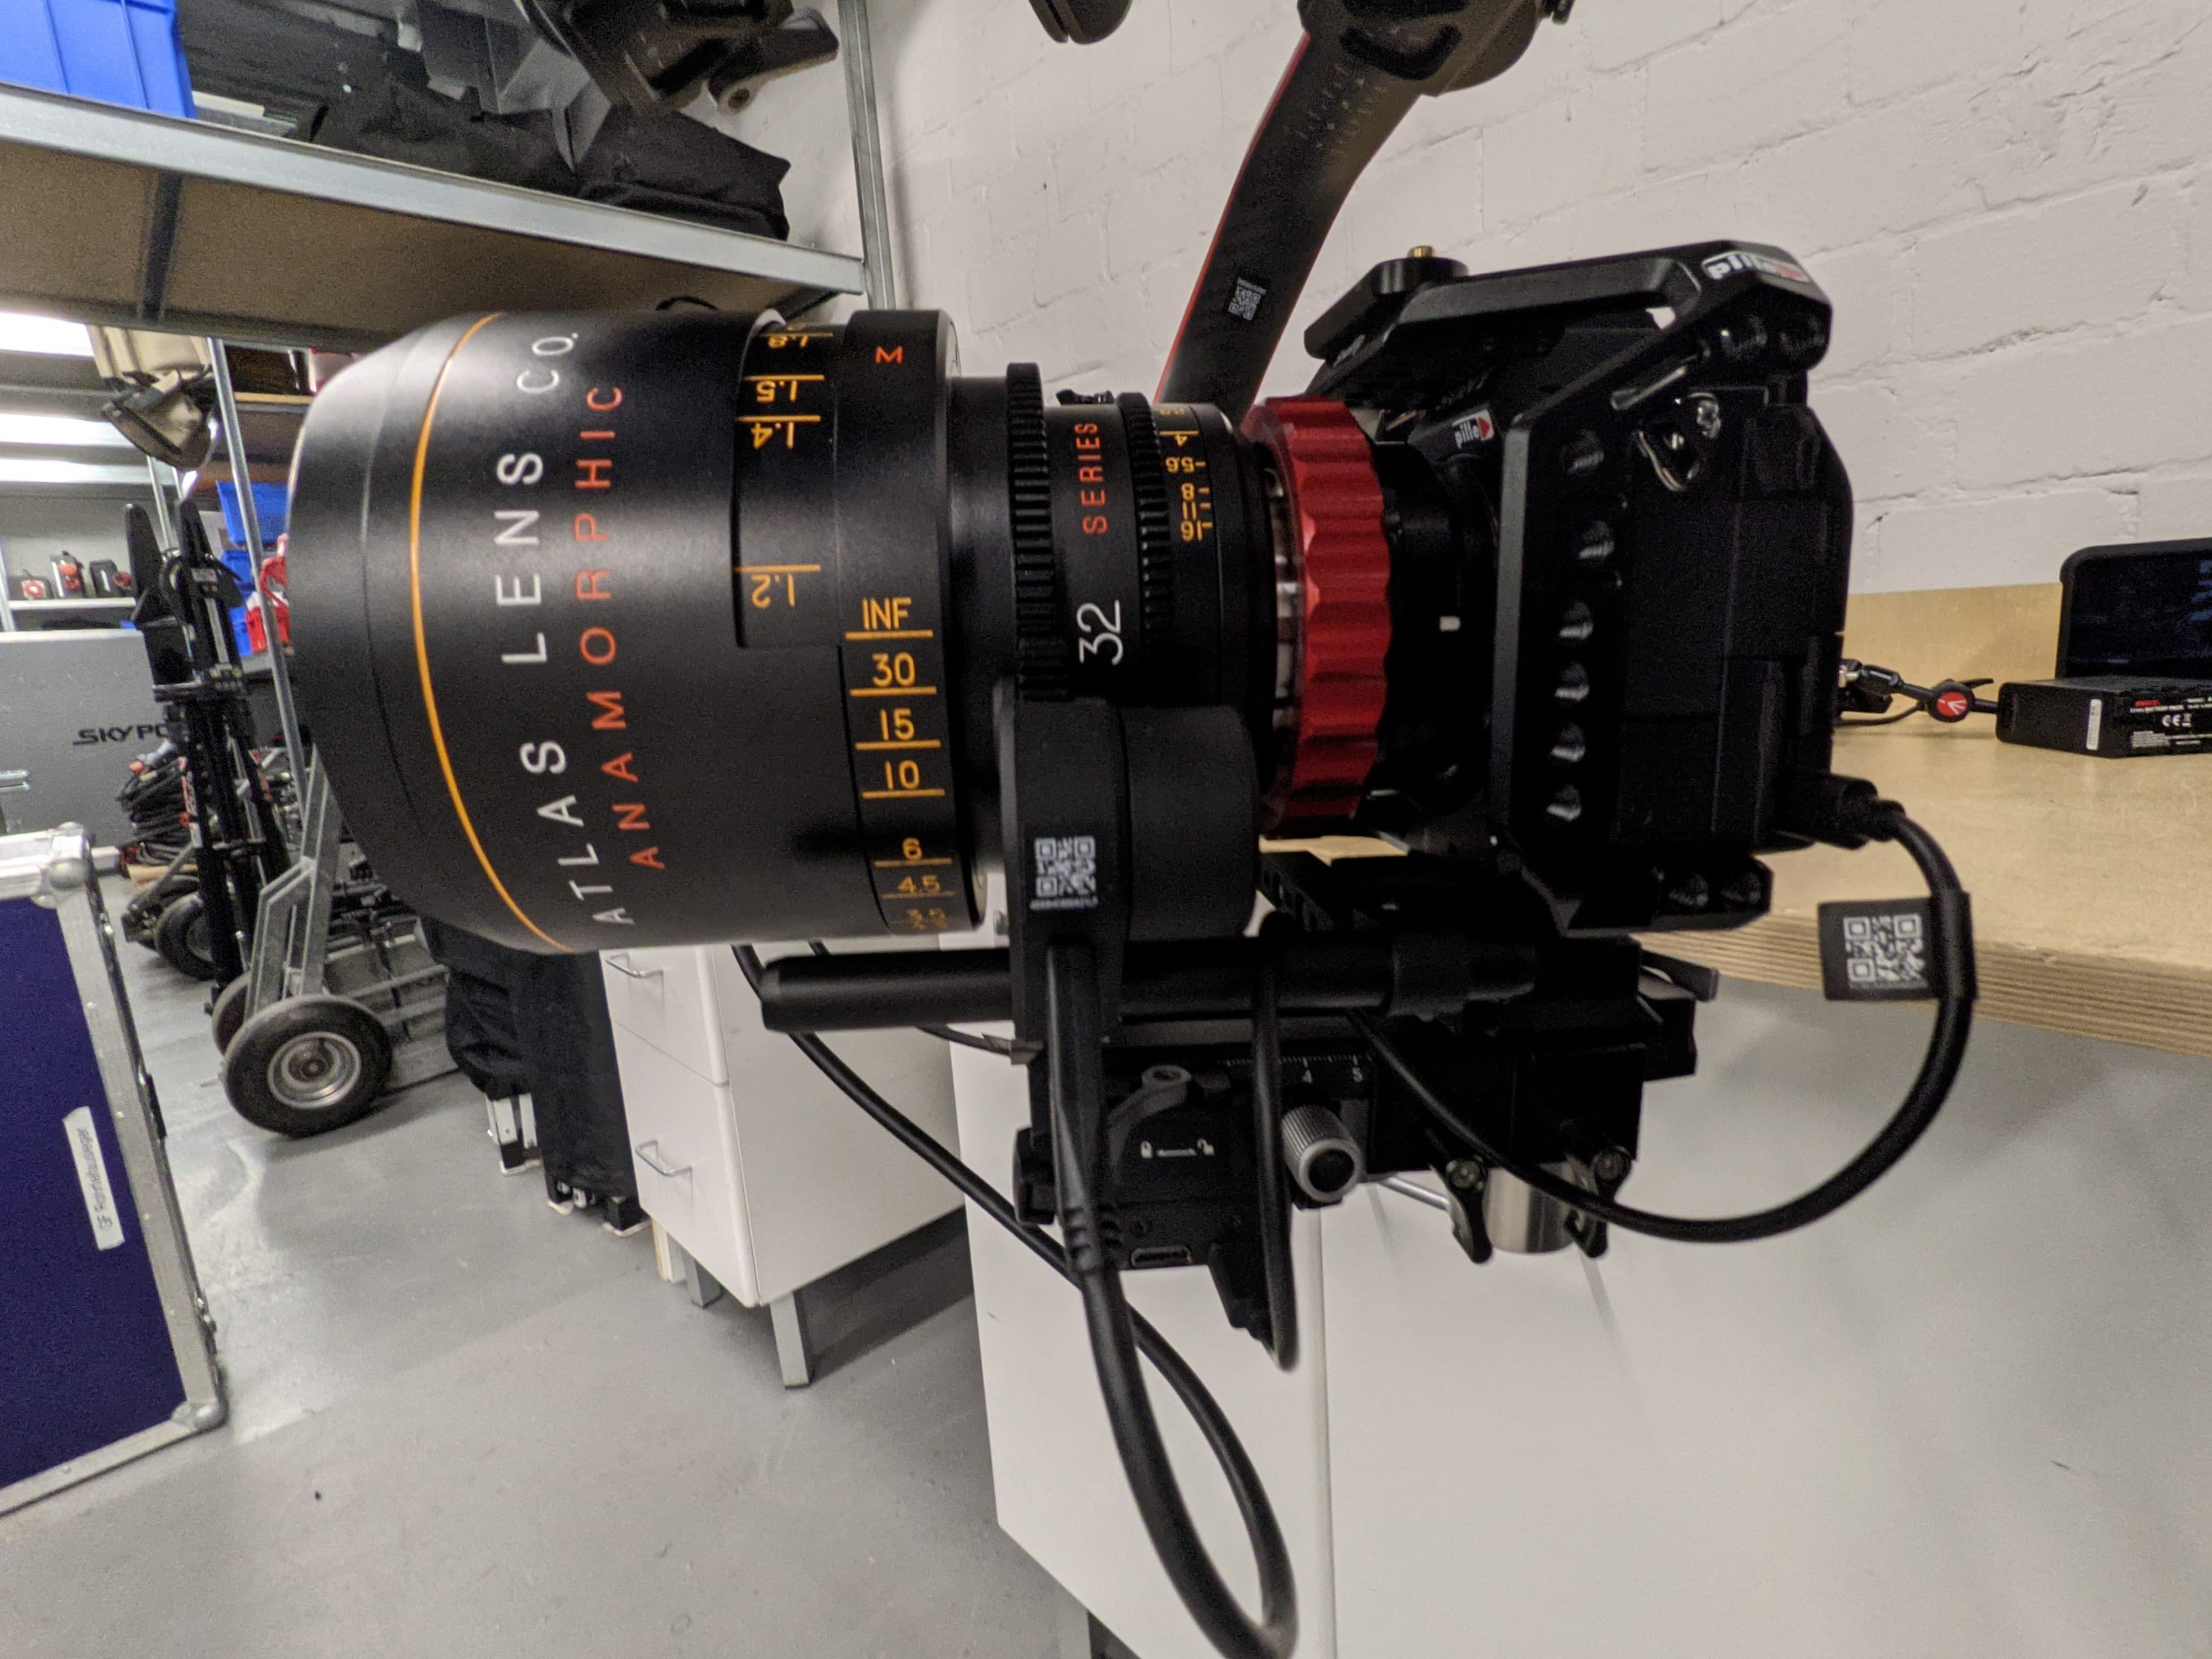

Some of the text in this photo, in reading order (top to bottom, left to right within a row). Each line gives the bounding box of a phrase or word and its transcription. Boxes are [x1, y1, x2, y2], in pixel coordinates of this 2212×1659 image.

[875, 346, 903, 364] M
[755, 380, 798, 404] 1.5
[750, 421, 795, 450] 1.4
[1174, 434, 1188, 447] 4
[1073, 422, 1109, 535] SERIES
[1181, 482, 1195, 501] 8
[1181, 500, 1198, 521] 11
[1180, 519, 1204, 542] 16
[750, 573, 796, 609] 1.2
[494, 333, 635, 925] ATLAS LENS CO.
[573, 387, 666, 870] ANAMORPHIC
[862, 597, 912, 630] INF
[1076, 599, 1124, 666] 32
[872, 651, 916, 687] 30
[879, 707, 916, 741] 15
[885, 759, 921, 791] 10
[902, 837, 923, 861] 6
